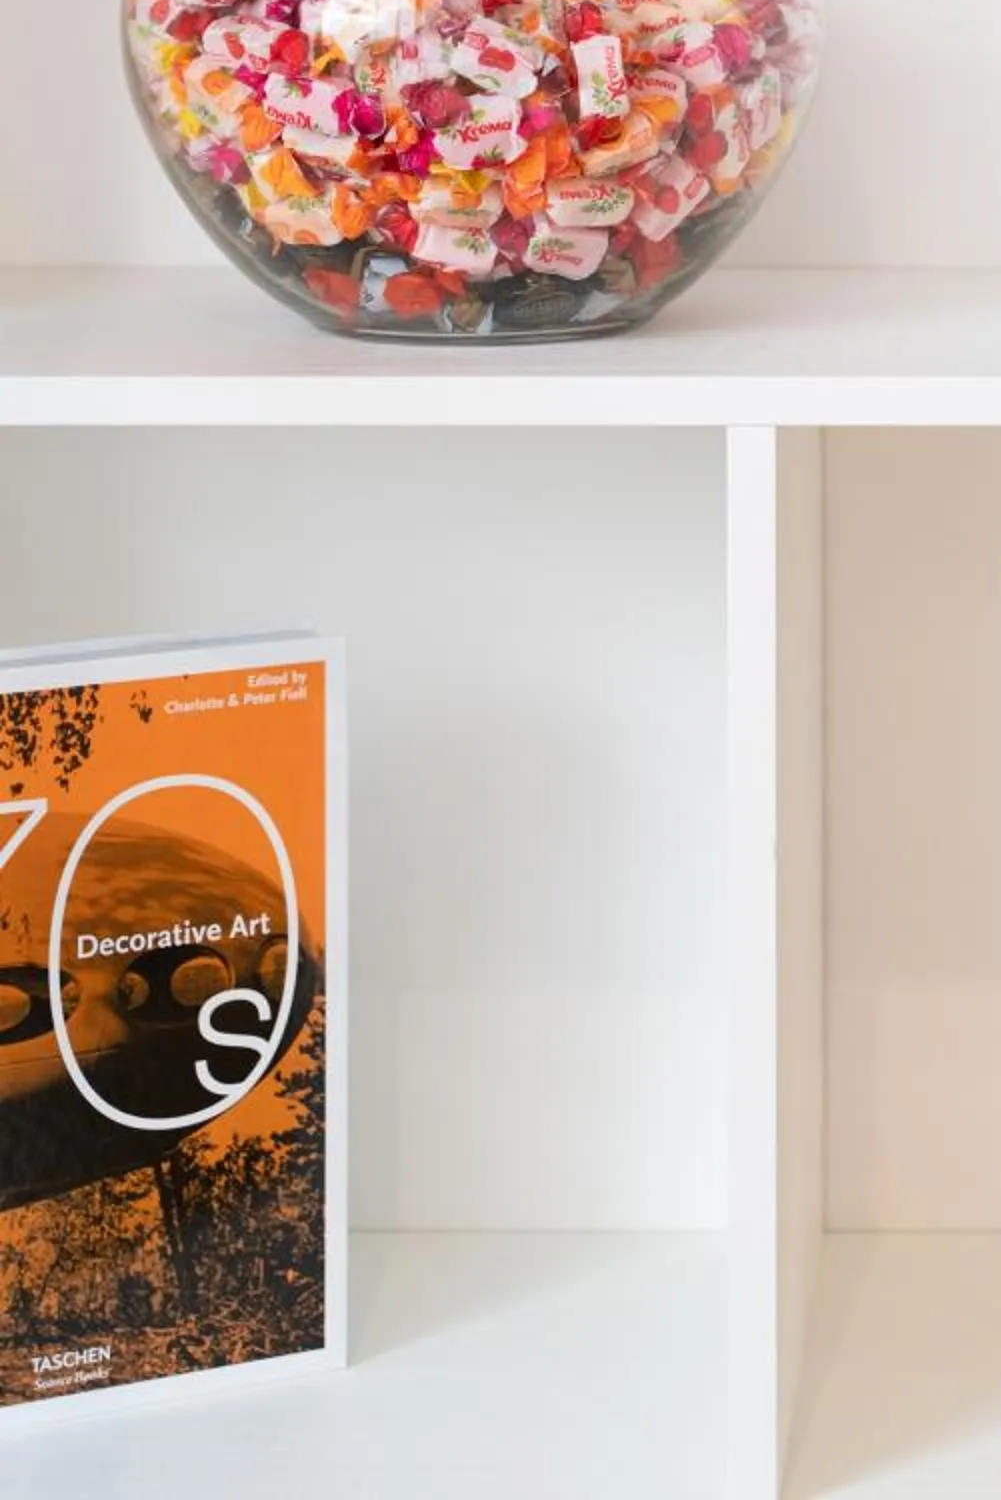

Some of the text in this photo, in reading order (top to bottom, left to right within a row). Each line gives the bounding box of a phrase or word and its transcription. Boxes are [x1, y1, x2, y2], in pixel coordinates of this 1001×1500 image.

[291, 668, 308, 686] by
[227, 692, 240, 708] &
[76, 911, 272, 960] Decorative Art
[31, 1344, 112, 1373] TASCHEN
